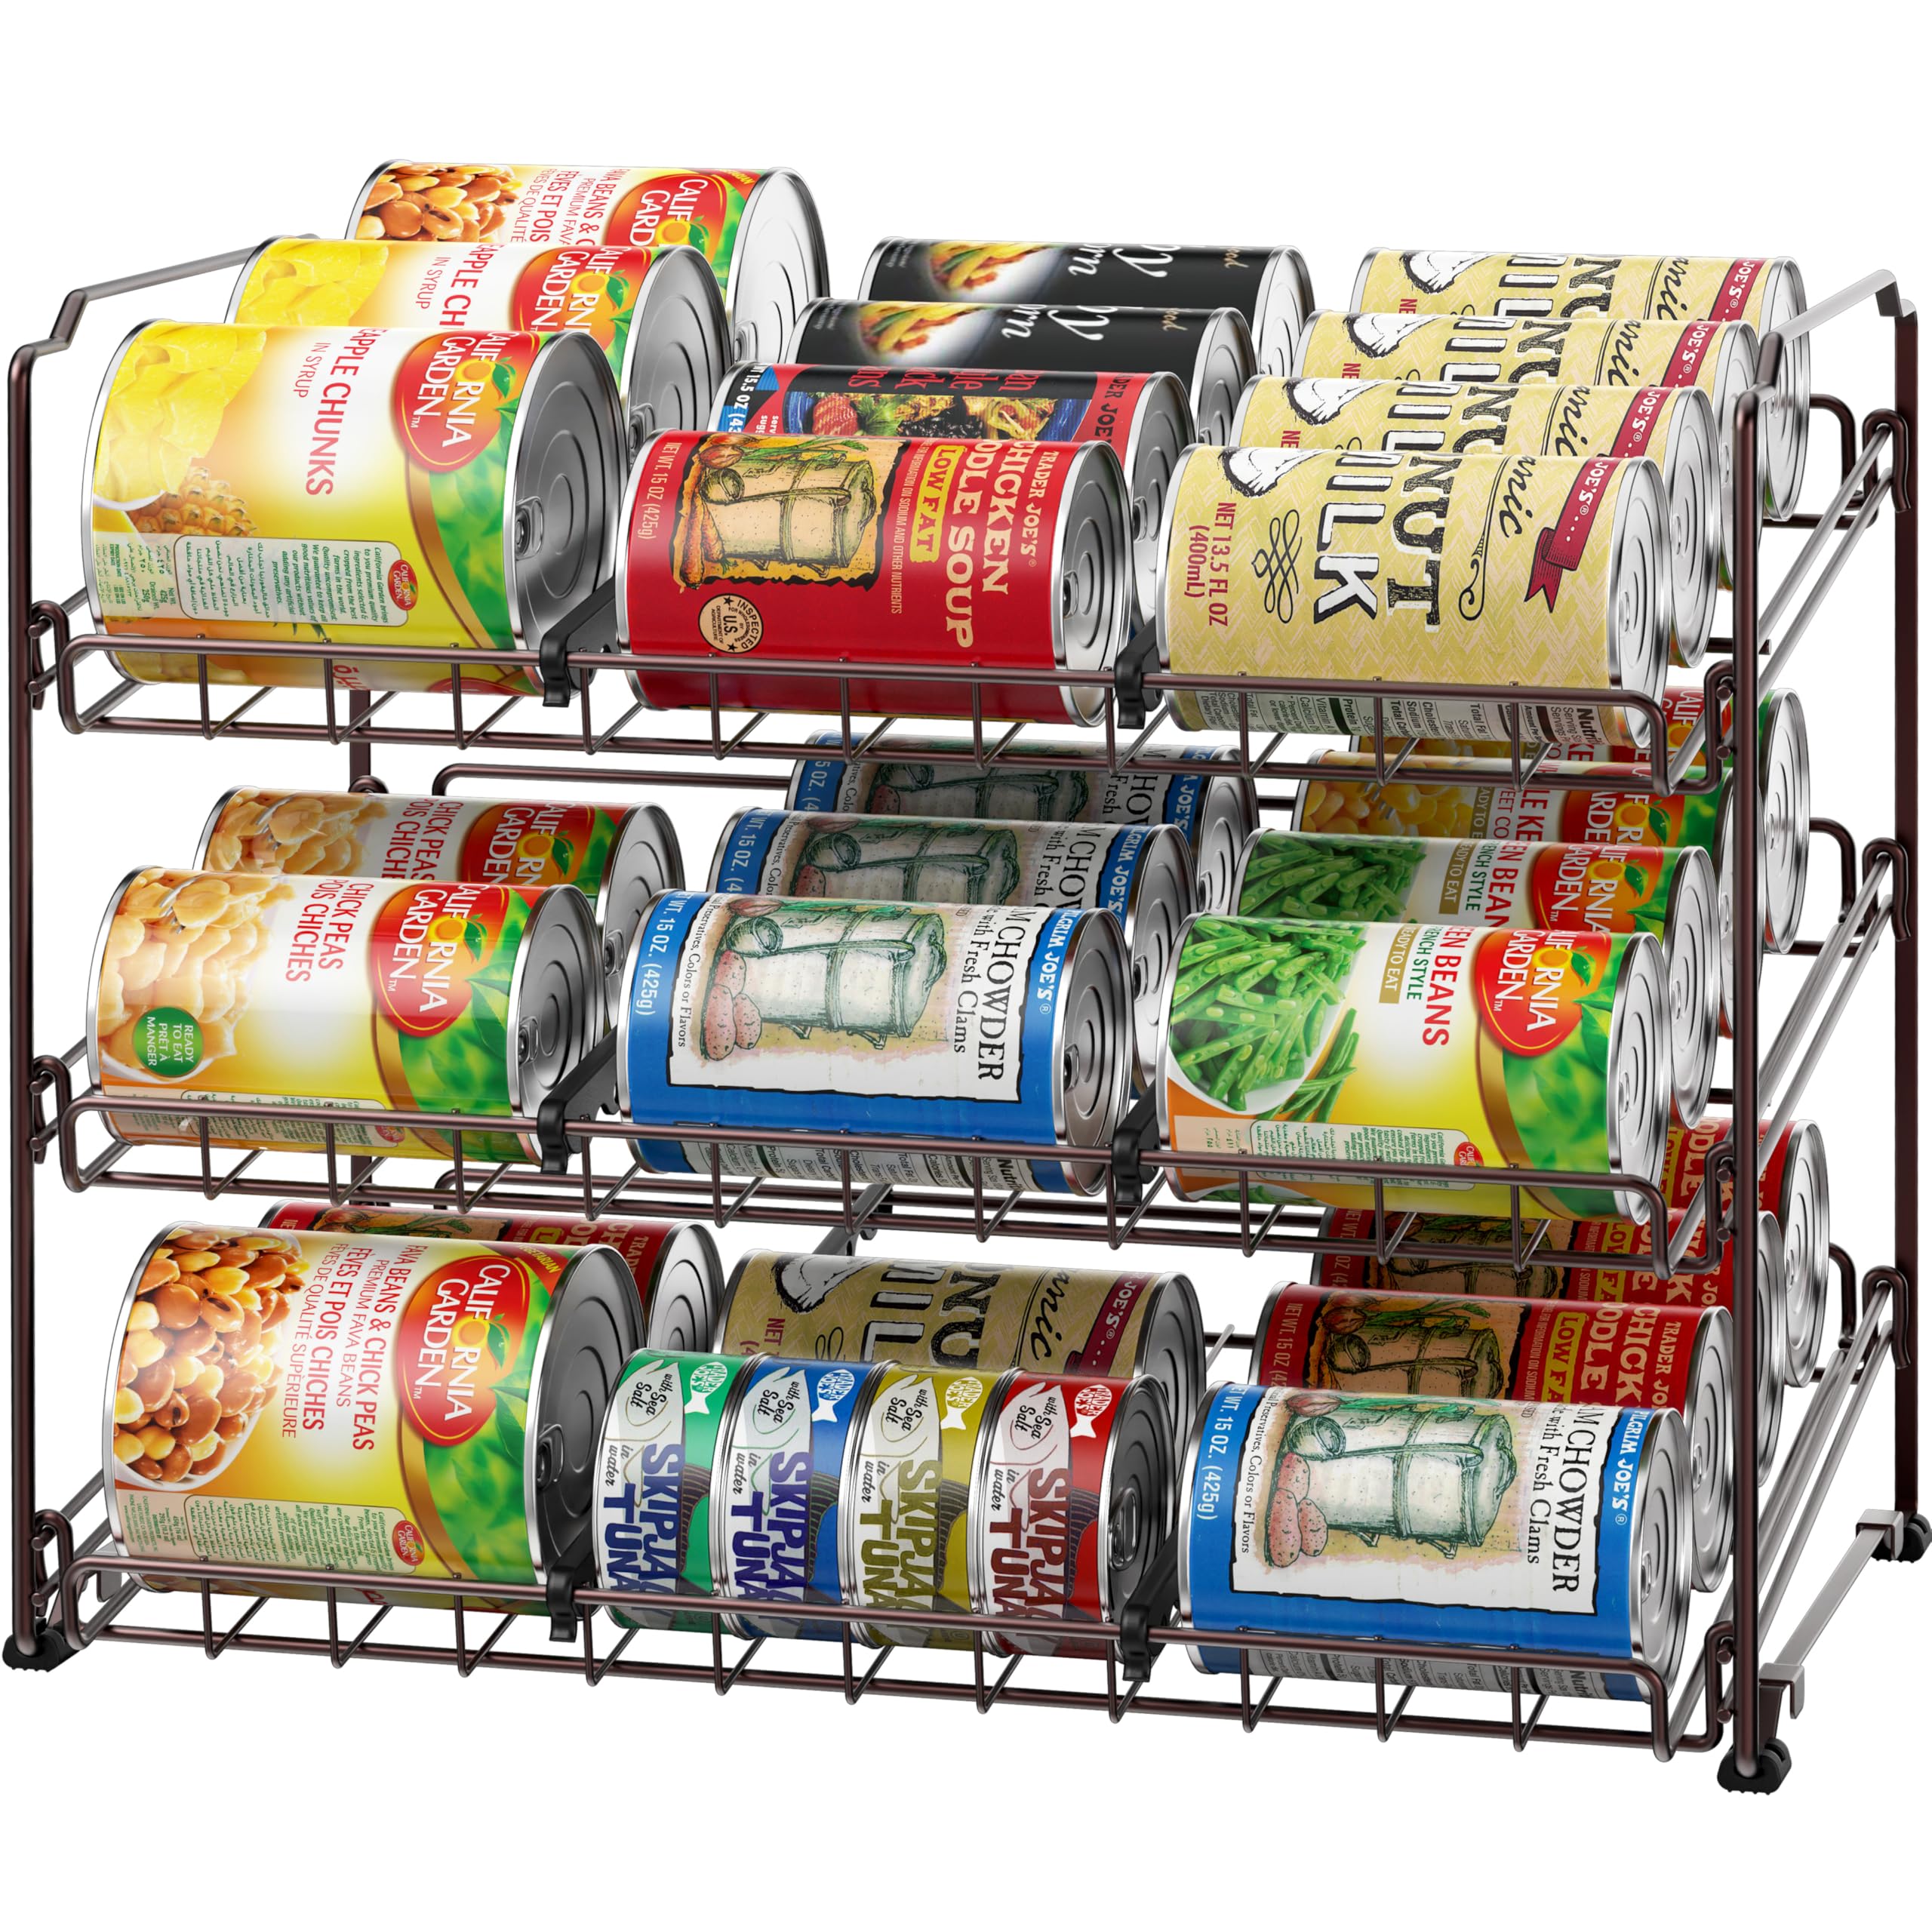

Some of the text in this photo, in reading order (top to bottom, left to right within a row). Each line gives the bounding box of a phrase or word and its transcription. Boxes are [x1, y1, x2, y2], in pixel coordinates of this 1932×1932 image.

[510, 197, 537, 243] QUALITÉ
[530, 193, 564, 242] ET POIS
[565, 177, 596, 216] PREMIUM
[583, 182, 617, 219] BEANS
[415, 269, 444, 309] SYRUP
[293, 342, 331, 398] IN SYRUP
[441, 331, 520, 448] CALIFORNIA
[733, 375, 757, 410] 15.5 OZ
[306, 382, 352, 495] CHUNKS
[638, 442, 683, 540] NET WT. 15 OZ (425g)
[926, 448, 957, 491] LOW
[952, 440, 1002, 515] ODLE
[1028, 451, 1060, 499] TRADER
[891, 454, 926, 615] INFORMATION SODIUM AND OTHER NUTRIENTS
[916, 496, 940, 553] FAT
[982, 441, 1041, 595] CHICKEN
[1384, 456, 1463, 632] NUT
[946, 525, 976, 648] SOUP
[1183, 524, 1211, 598] (400mL)
[1208, 502, 1236, 627] NET 13.5 FL OZ
[722, 615, 738, 635] U.S.
[737, 599, 759, 650] INSPECTED
[423, 800, 465, 835] CHICK
[1103, 775, 1129, 814] Fresh
[730, 817, 768, 872] WT. 15 OZ.
[1034, 831, 1068, 897] with Fresh
[1444, 881, 1460, 904] EAT
[1466, 871, 1487, 912] STYLE
[285, 878, 349, 982] POIS CHICHES
[318, 883, 375, 970] CHICK PEAS
[420, 883, 478, 1013] CALIFORNIA
[973, 914, 996, 937] with
[635, 898, 688, 1016] WT. 15 OZ. (425g)
[678, 902, 720, 1048] Preservatives, Colors or Flavors
[961, 940, 990, 984] Fresh
[1386, 949, 1404, 991] TO EAT
[1406, 958, 1429, 1001] STYLE
[953, 990, 978, 1054] Clams
[978, 925, 1026, 1080] CHOWDER
[1422, 955, 1462, 1046] BEANS
[146, 1017, 158, 1066] MANGER
[158, 1023, 169, 1051] PRÊT
[173, 1023, 183, 1063] TO EAT
[183, 1025, 194, 1063] READY
[313, 1268, 332, 1282] DE
[294, 1284, 325, 1341] QUALITÉ
[337, 1260, 389, 1407] PREMIUM FAVA BEANS
[1273, 1303, 1303, 1367] NET WT. 15 OZ
[302, 1247, 373, 1431] FÈVES ET POIS CHICHES
[352, 1244, 429, 1450] FAVA BEANS & CHICK PEAS
[444, 1264, 511, 1421] CALIFORNIA
[1553, 1316, 1579, 1364] LOW
[1655, 1321, 1681, 1374] TRADER
[630, 1382, 652, 1408] Salt
[645, 1374, 672, 1416] with Sea
[757, 1389, 779, 1416] Salt
[773, 1381, 800, 1423] with Sea
[901, 1389, 928, 1431] with Sea
[1524, 1368, 1537, 1400] SODIUM
[885, 1397, 906, 1424] Salt
[1014, 1405, 1036, 1432] Salt
[1031, 1396, 1057, 1439] with Sea
[605, 1444, 619, 1487] water
[620, 1444, 633, 1460] in
[733, 1453, 746, 1494] water
[748, 1452, 761, 1467] in
[877, 1460, 891, 1475] in
[1008, 1468, 1020, 1484] in
[1196, 1394, 1243, 1520] WT. 15 OZ. (425g)
[1241, 1401, 1278, 1553] Preservatives, Colors or Flavors
[861, 1461, 875, 1503] water
[991, 1469, 1004, 1511] water
[1527, 1417, 1565, 1564] with Fresh Clams
[638, 1443, 685, 1594] SKIPJA
[764, 1451, 813, 1603] SKIPJA
[897, 1460, 943, 1611] SKIPJA
[1552, 1429, 1595, 1592] CHOWDER
[604, 1482, 642, 1594] TUNA
[731, 1491, 771, 1601] TUNA
[859, 1499, 900, 1607] TUNA
[989, 1507, 1029, 1617] TUNA
[1025, 1467, 1073, 1619] SKIPJA
